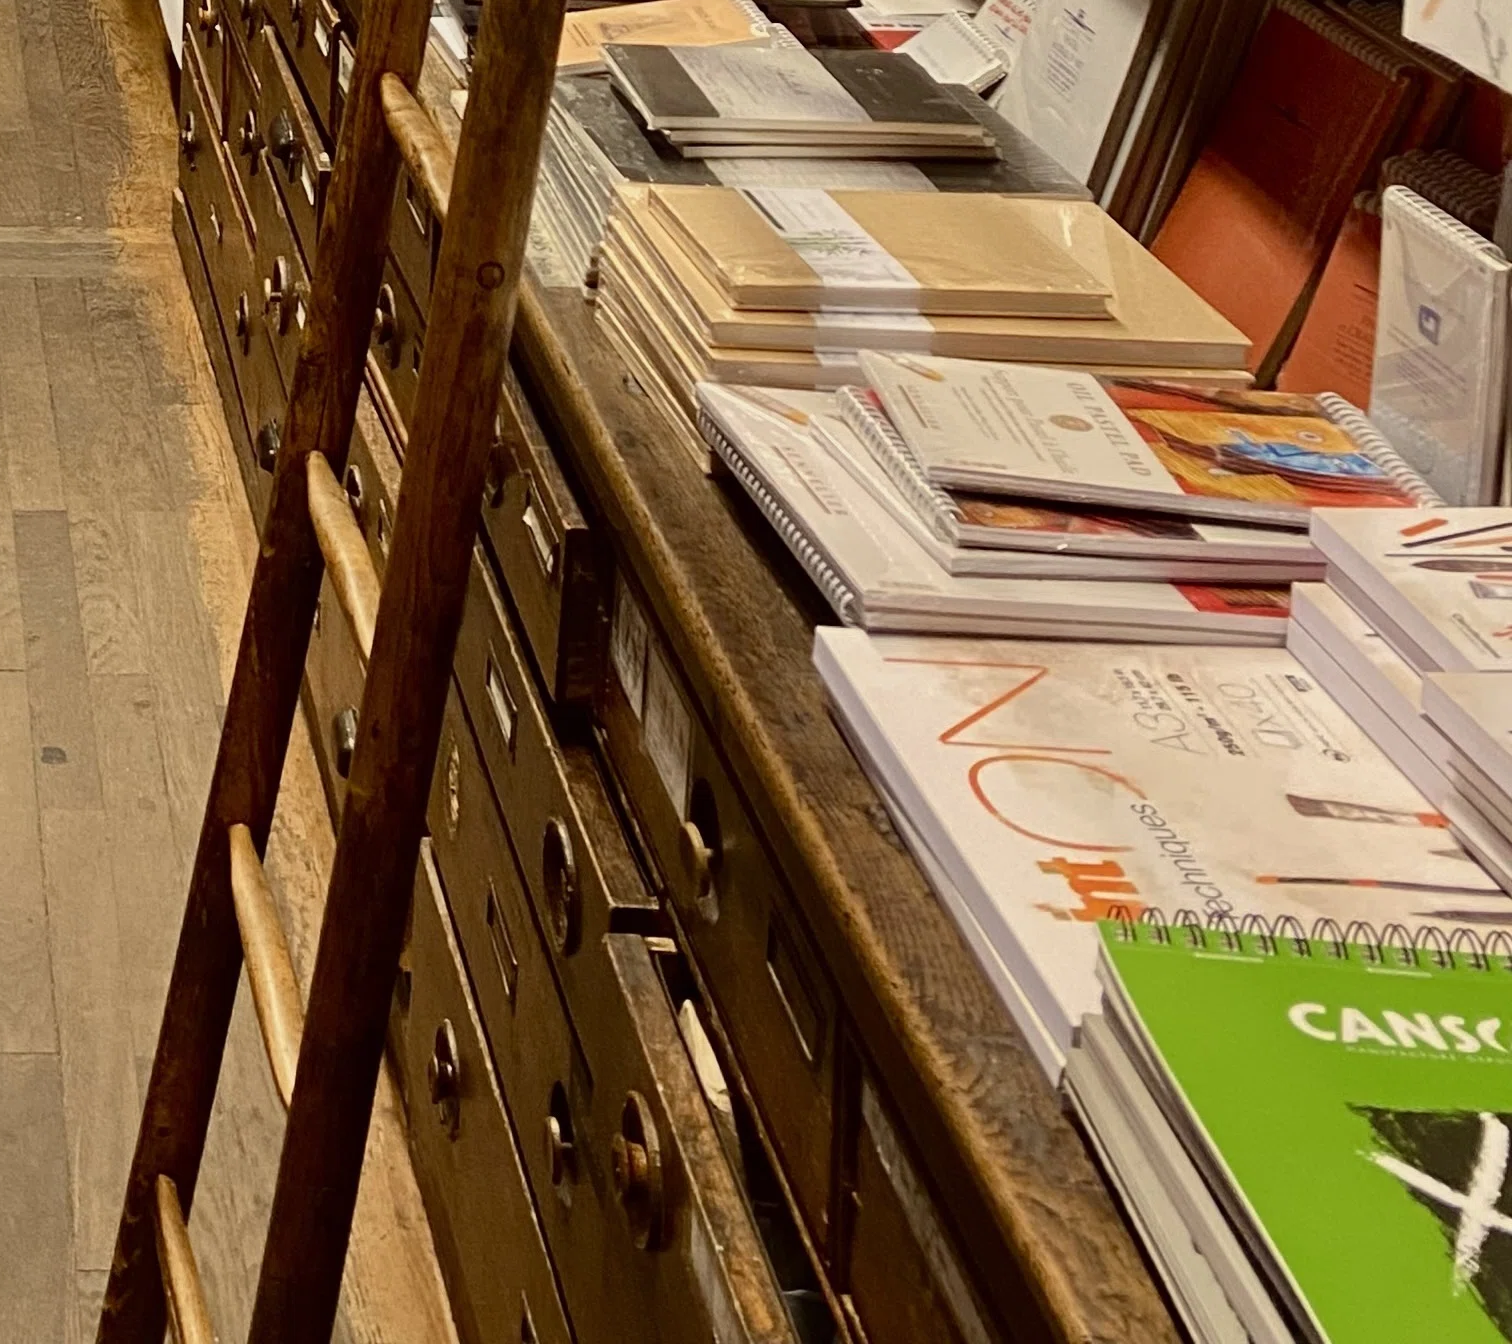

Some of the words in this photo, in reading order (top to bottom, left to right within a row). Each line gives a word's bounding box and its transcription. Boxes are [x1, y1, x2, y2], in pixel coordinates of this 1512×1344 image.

[1065, 381, 1090, 402] OIL
[1088, 404, 1131, 447] PASTEL
[1118, 450, 1152, 477] PAD
[1131, 802, 1238, 919] echniques
